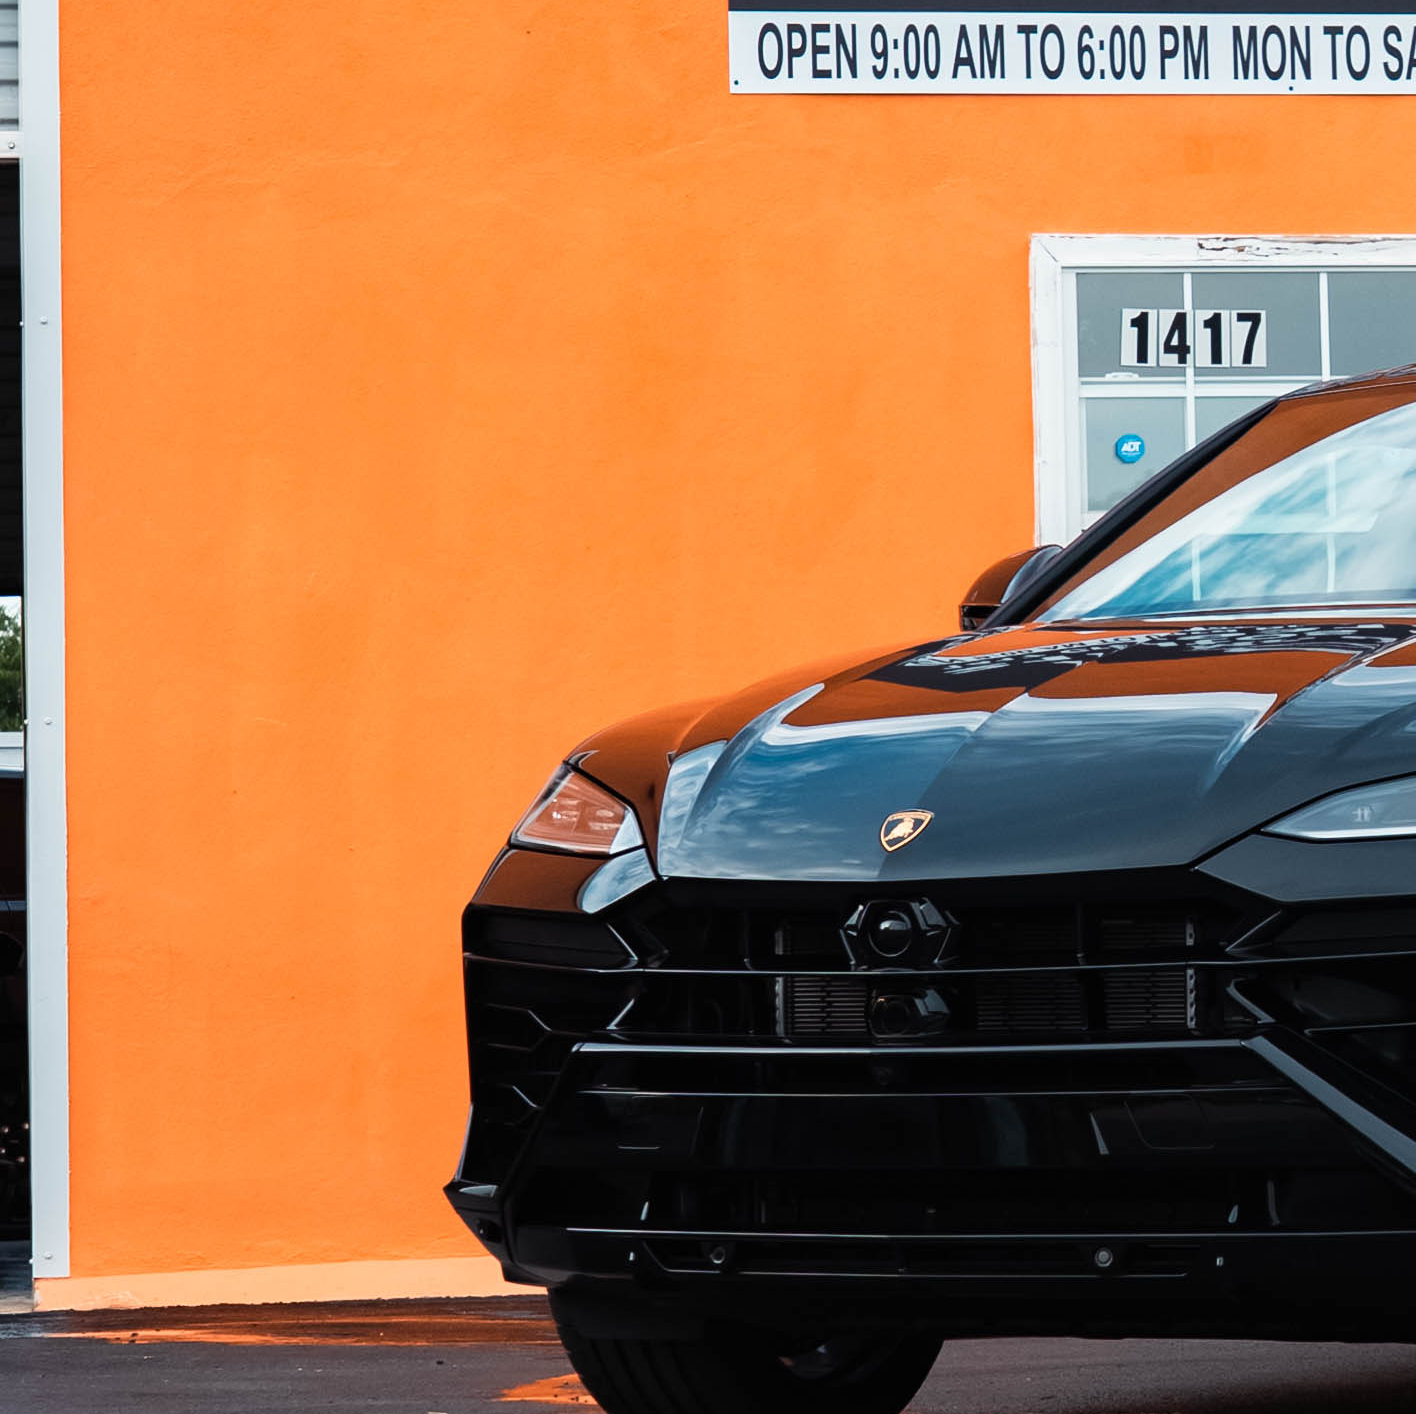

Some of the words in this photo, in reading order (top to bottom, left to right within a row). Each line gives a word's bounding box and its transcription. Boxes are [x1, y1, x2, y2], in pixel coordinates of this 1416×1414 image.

[758, 23, 857, 79] OPEN
[871, 24, 940, 79] 9:00
[952, 25, 1005, 78] AM
[1017, 24, 1064, 79] TO
[1078, 25, 1145, 80] 6:00
[1160, 26, 1208, 79] PM
[1233, 25, 1311, 80] MON
[1324, 26, 1370, 80] TO
[1130, 311, 1262, 365] 1417
[1121, 441, 1141, 452] ADT
